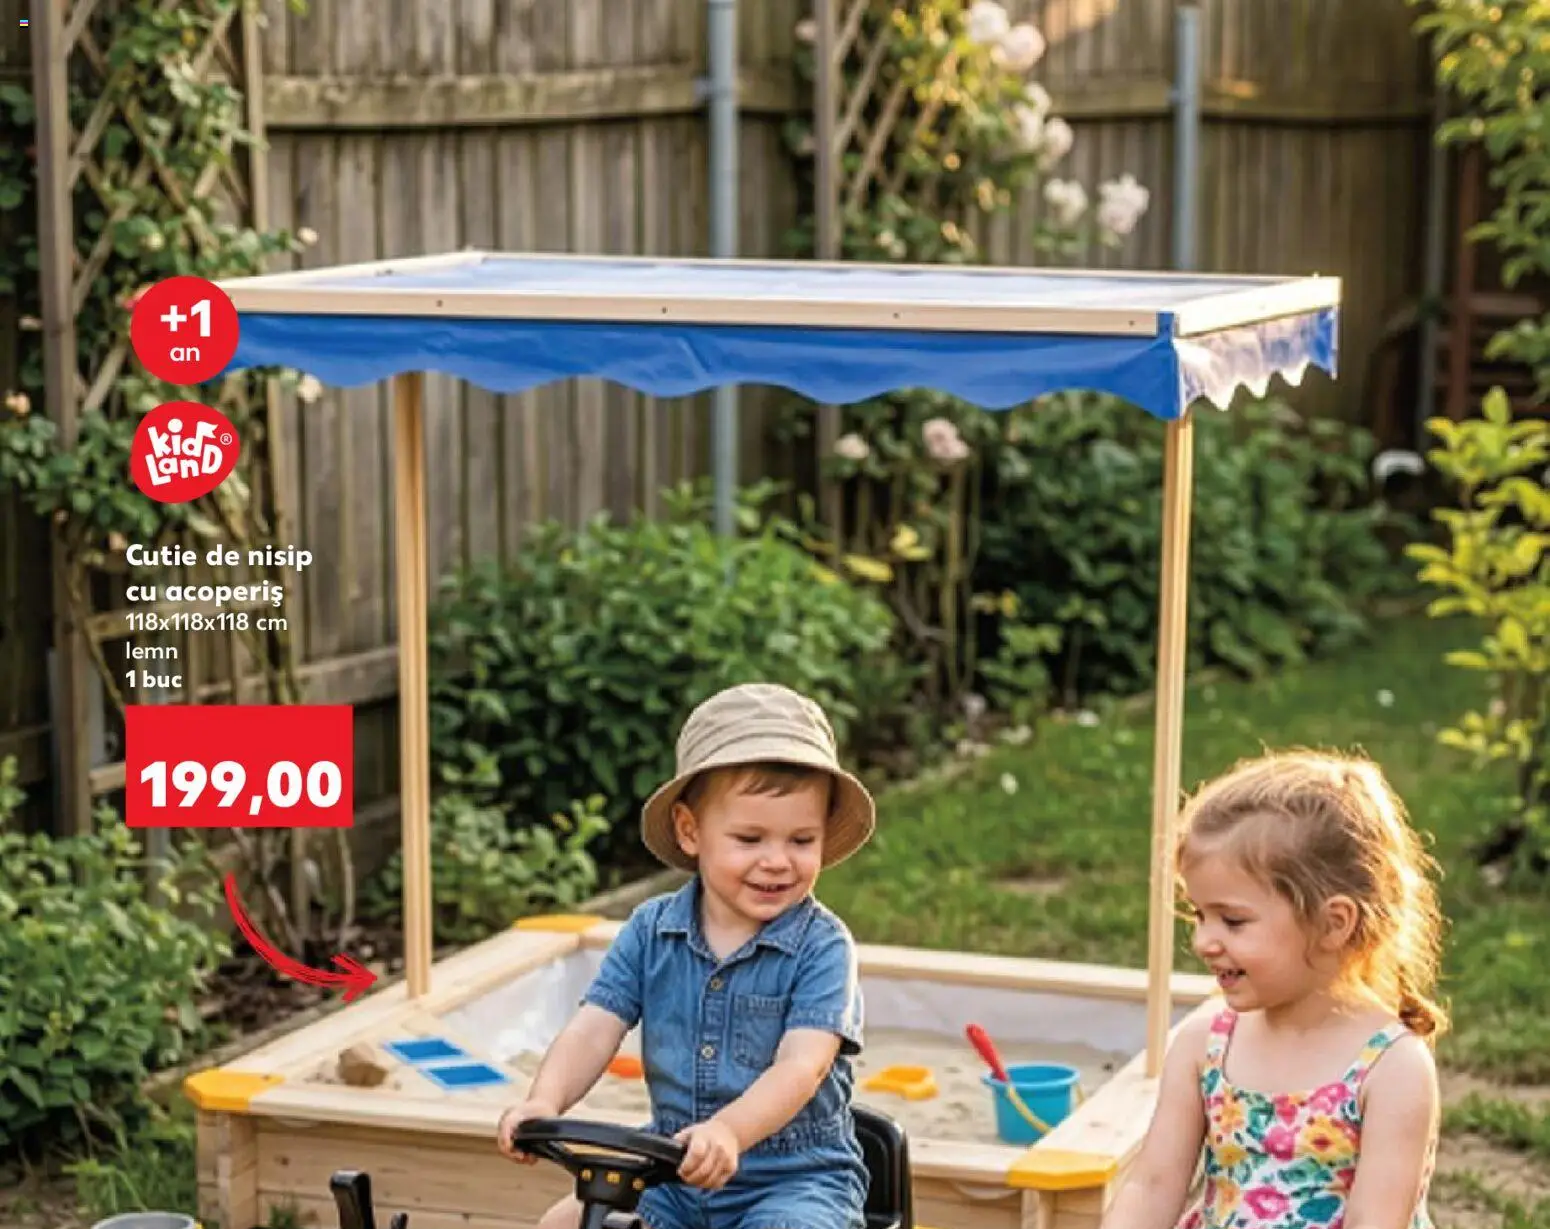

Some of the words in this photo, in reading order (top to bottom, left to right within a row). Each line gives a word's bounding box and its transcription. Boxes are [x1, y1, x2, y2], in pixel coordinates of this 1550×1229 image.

[161, 299, 210, 337] +1
[170, 347, 200, 361] an
[126, 543, 197, 566] Cutie
[206, 544, 240, 566] de
[248, 544, 313, 572] nisip
[126, 585, 156, 601] cu
[125, 612, 249, 631] 118x118x118
[256, 618, 287, 631] cm
[126, 641, 178, 659] lemn
[125, 670, 135, 688] 1
[143, 670, 182, 688] buc
[141, 760, 342, 815] 199,00
